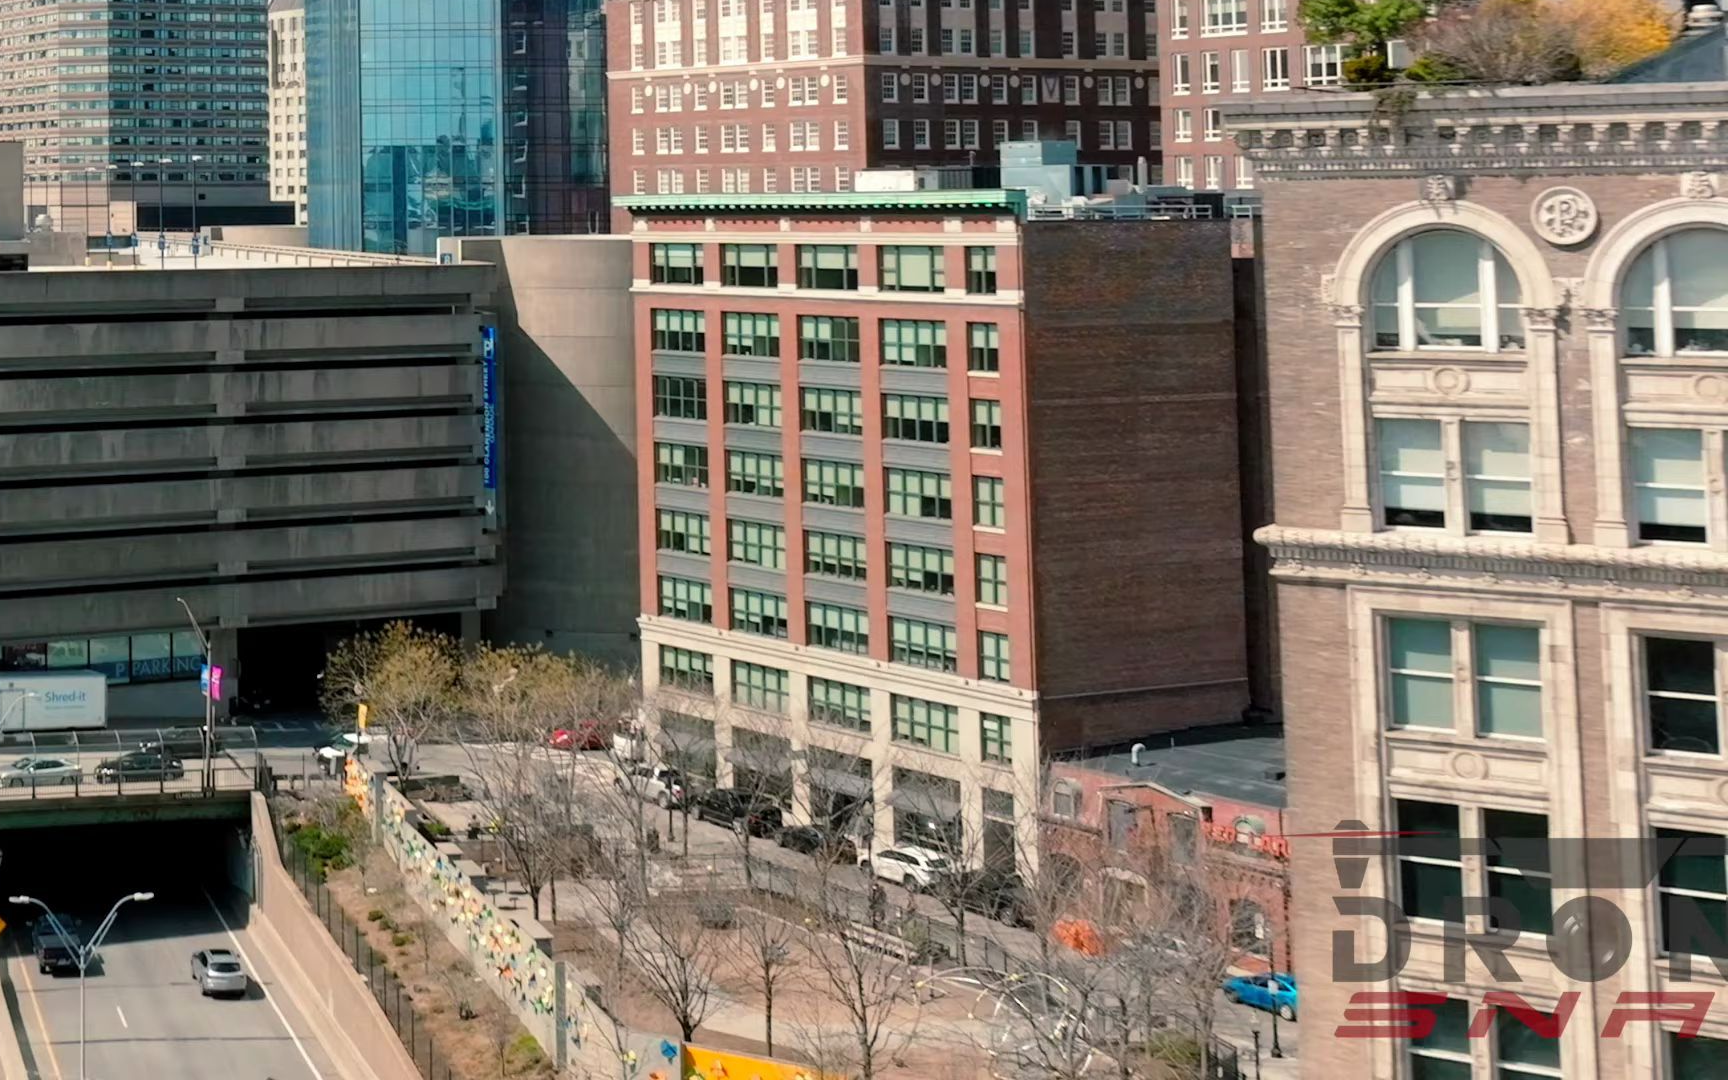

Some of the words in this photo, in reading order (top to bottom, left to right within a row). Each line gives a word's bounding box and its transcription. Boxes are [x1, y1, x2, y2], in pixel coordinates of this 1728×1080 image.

[115, 663, 125, 678] P
[132, 656, 202, 676] PARKING
[44, 688, 86, 703] Shred-it
